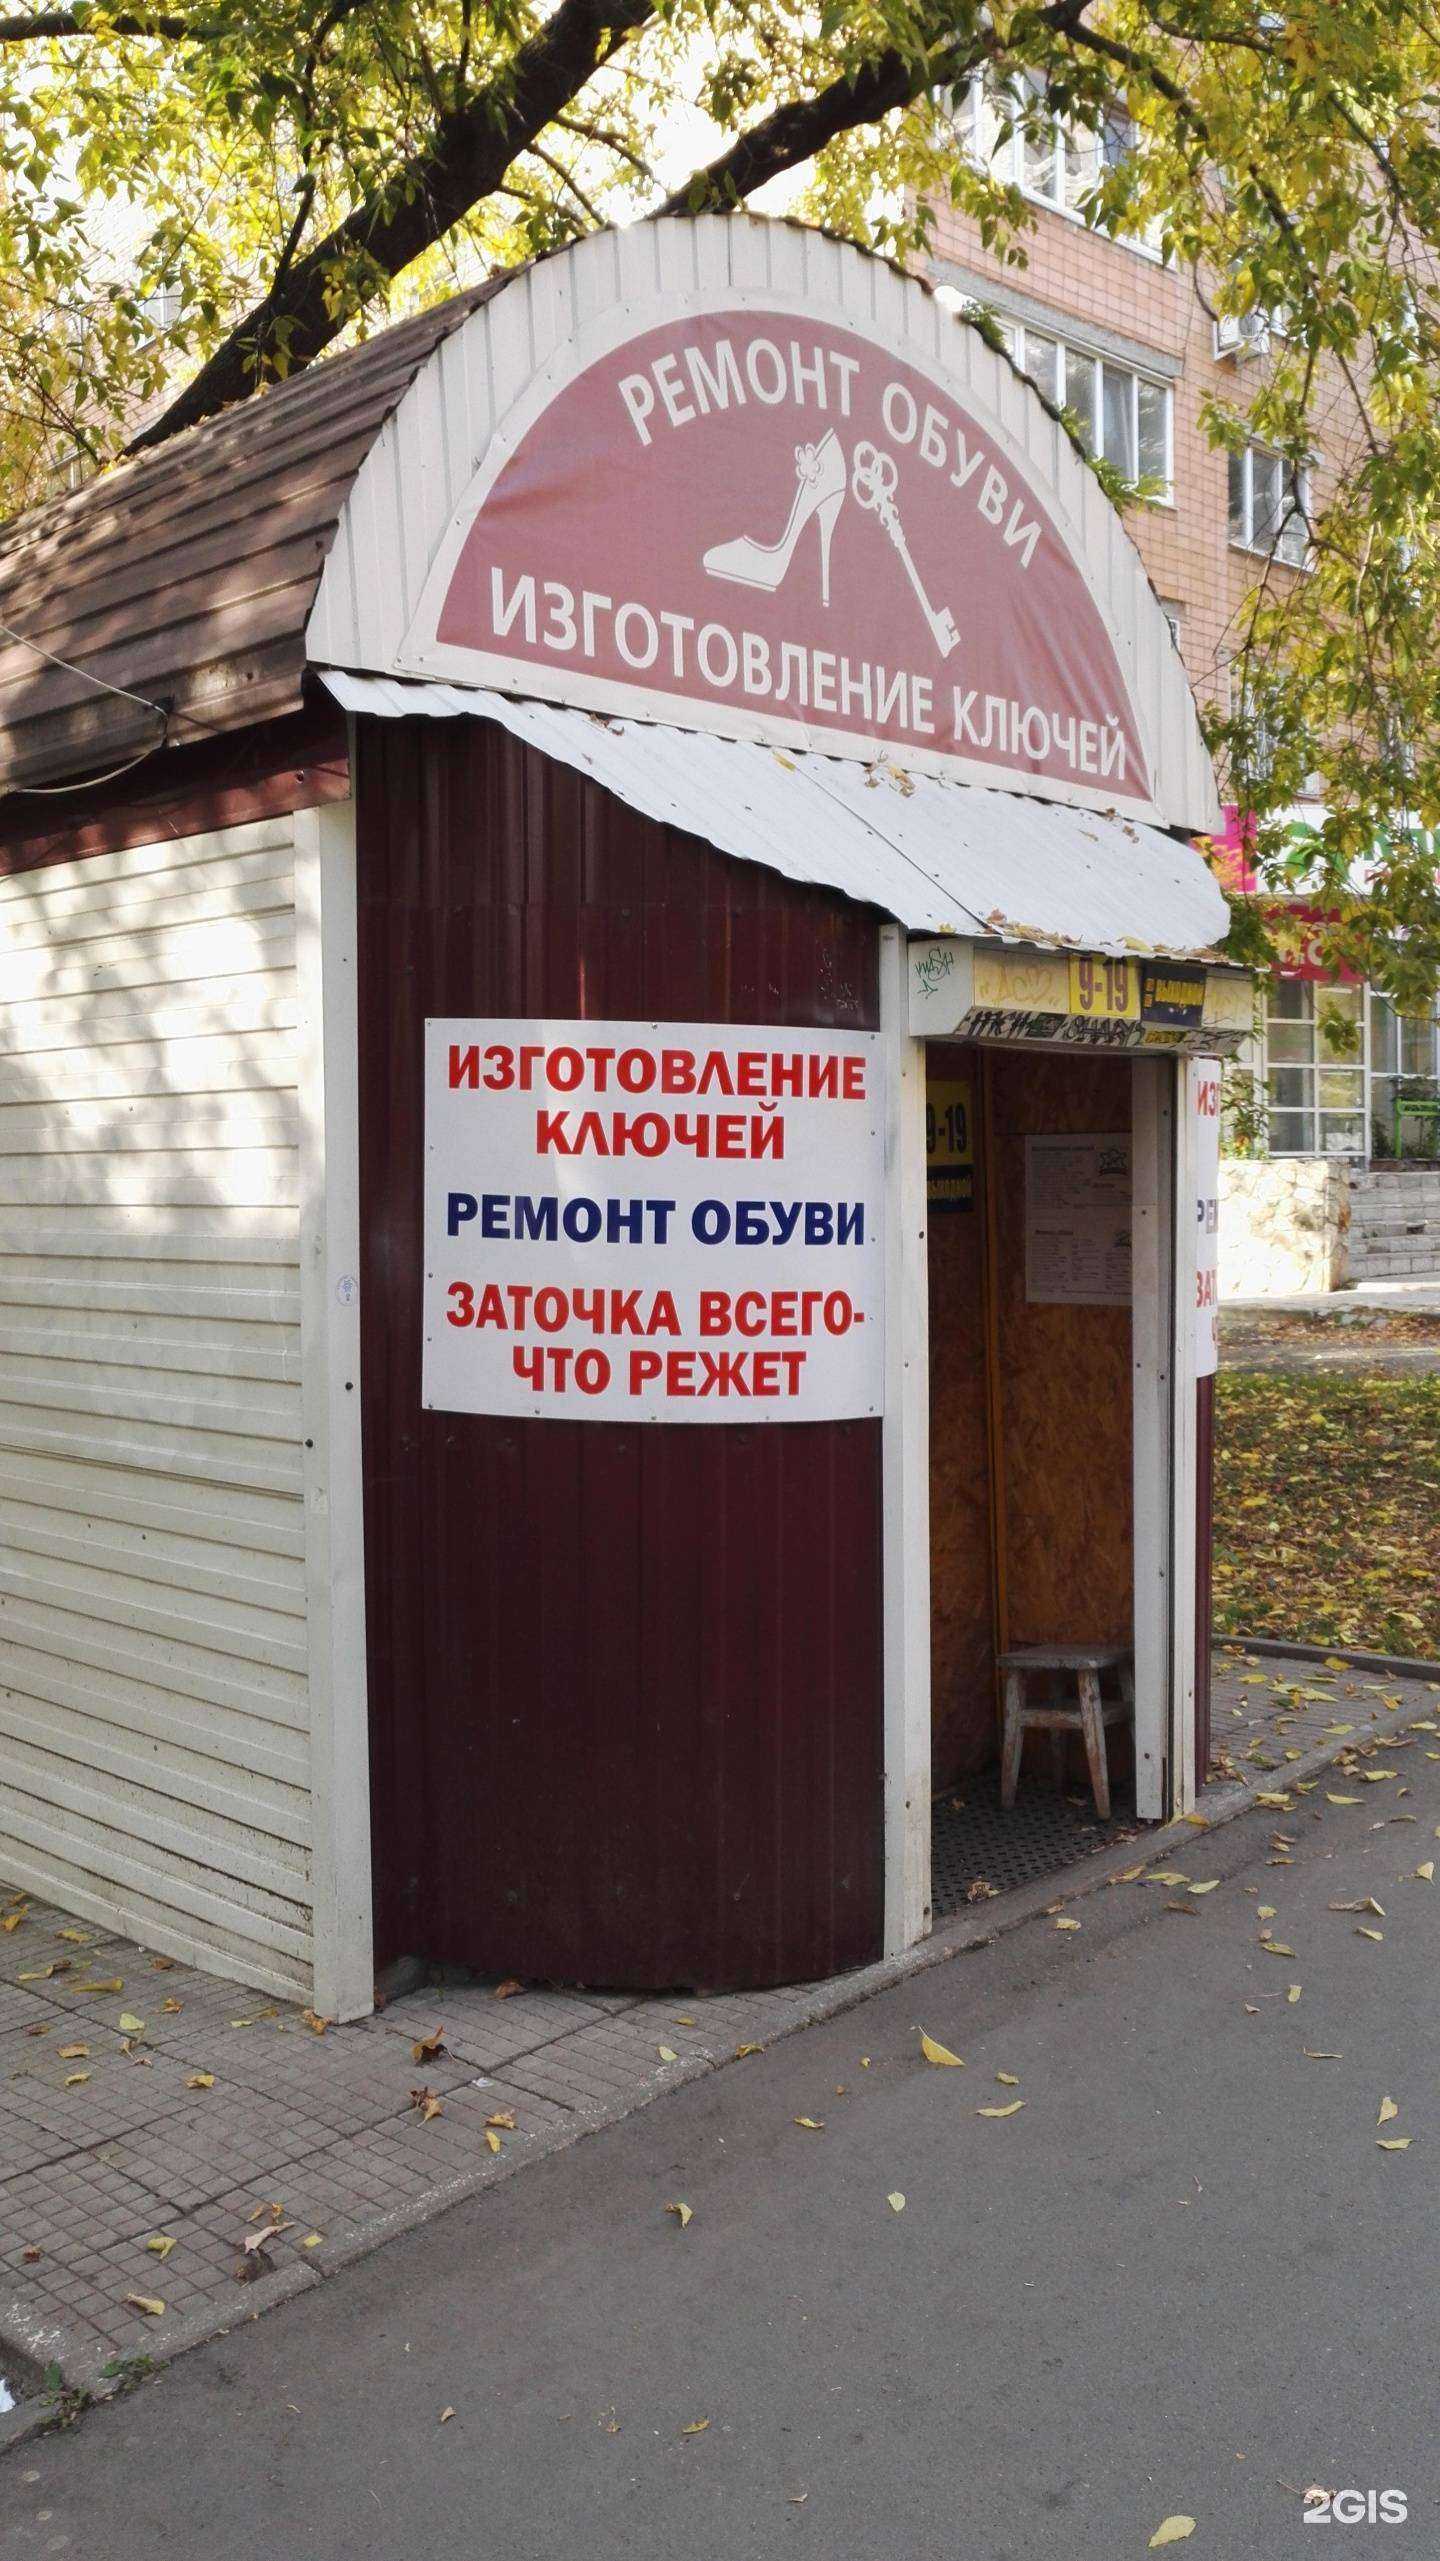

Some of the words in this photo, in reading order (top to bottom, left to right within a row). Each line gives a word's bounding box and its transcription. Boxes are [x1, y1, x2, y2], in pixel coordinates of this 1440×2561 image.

[618, 338, 860, 446] РЕМОНТ
[881, 383, 1043, 568] ОБУВИ
[490, 567, 936, 735] ИЗГОТОВЛЕНИЕ
[953, 686, 1127, 782] КЛЮЧЕЙ
[1079, 956, 1129, 1012] 9-19
[448, 1044, 866, 1100] ИЗГОТОВЛЕНИЕ
[536, 1101, 785, 1160] КЛЮЧЕЙ
[926, 1102, 966, 1153] 9-19
[447, 1192, 676, 1244] РЕМОНТ
[691, 1200, 865, 1246] ОБУВИ
[446, 1281, 682, 1337] ЗАТОЧКА
[699, 1290, 865, 1337] ВСЕГО-
[512, 1345, 611, 1396] ЧТО
[628, 1350, 807, 1397] РЕЖЕТ
